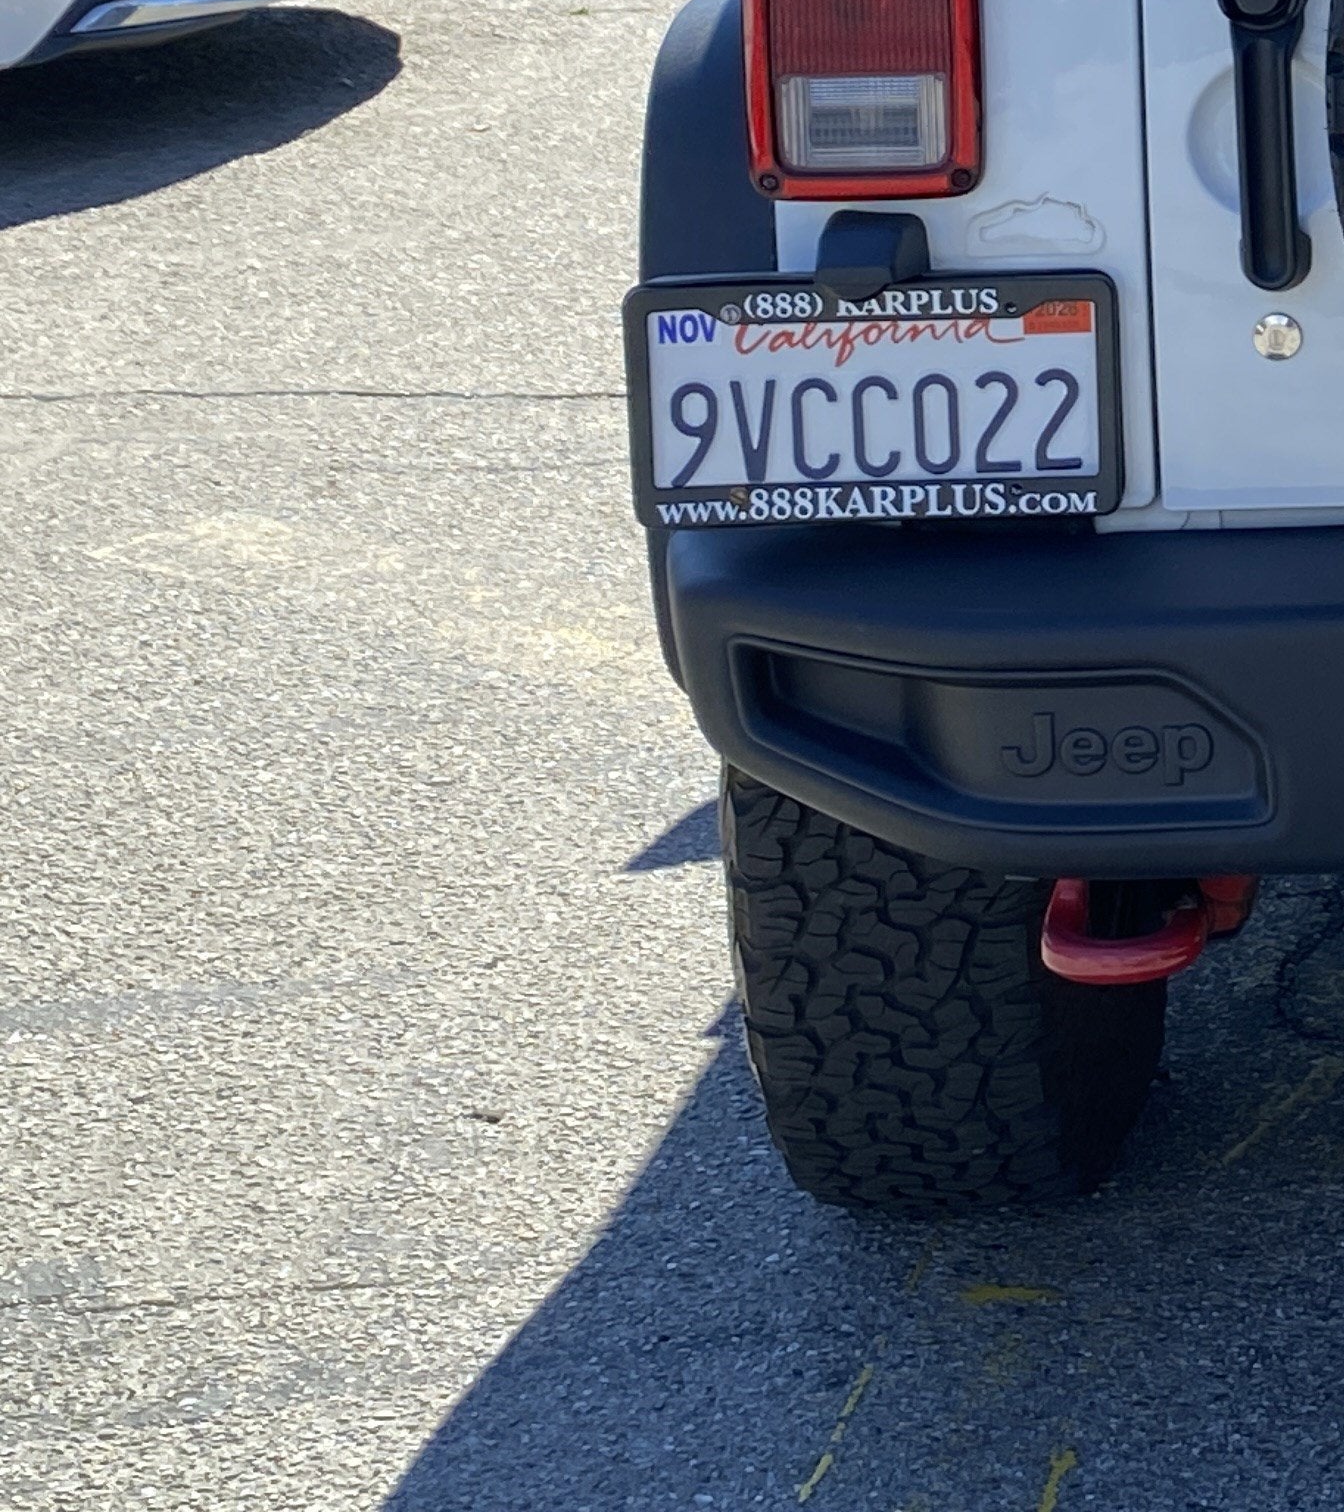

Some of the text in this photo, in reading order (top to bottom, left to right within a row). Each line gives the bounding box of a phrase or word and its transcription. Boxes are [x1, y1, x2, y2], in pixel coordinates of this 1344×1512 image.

[743, 288, 998, 318] (888) KARPLUS
[657, 314, 716, 344] NOV
[735, 317, 1025, 367] California
[669, 368, 1083, 487] 9VCC022
[1000, 711, 1214, 786] Jeep
